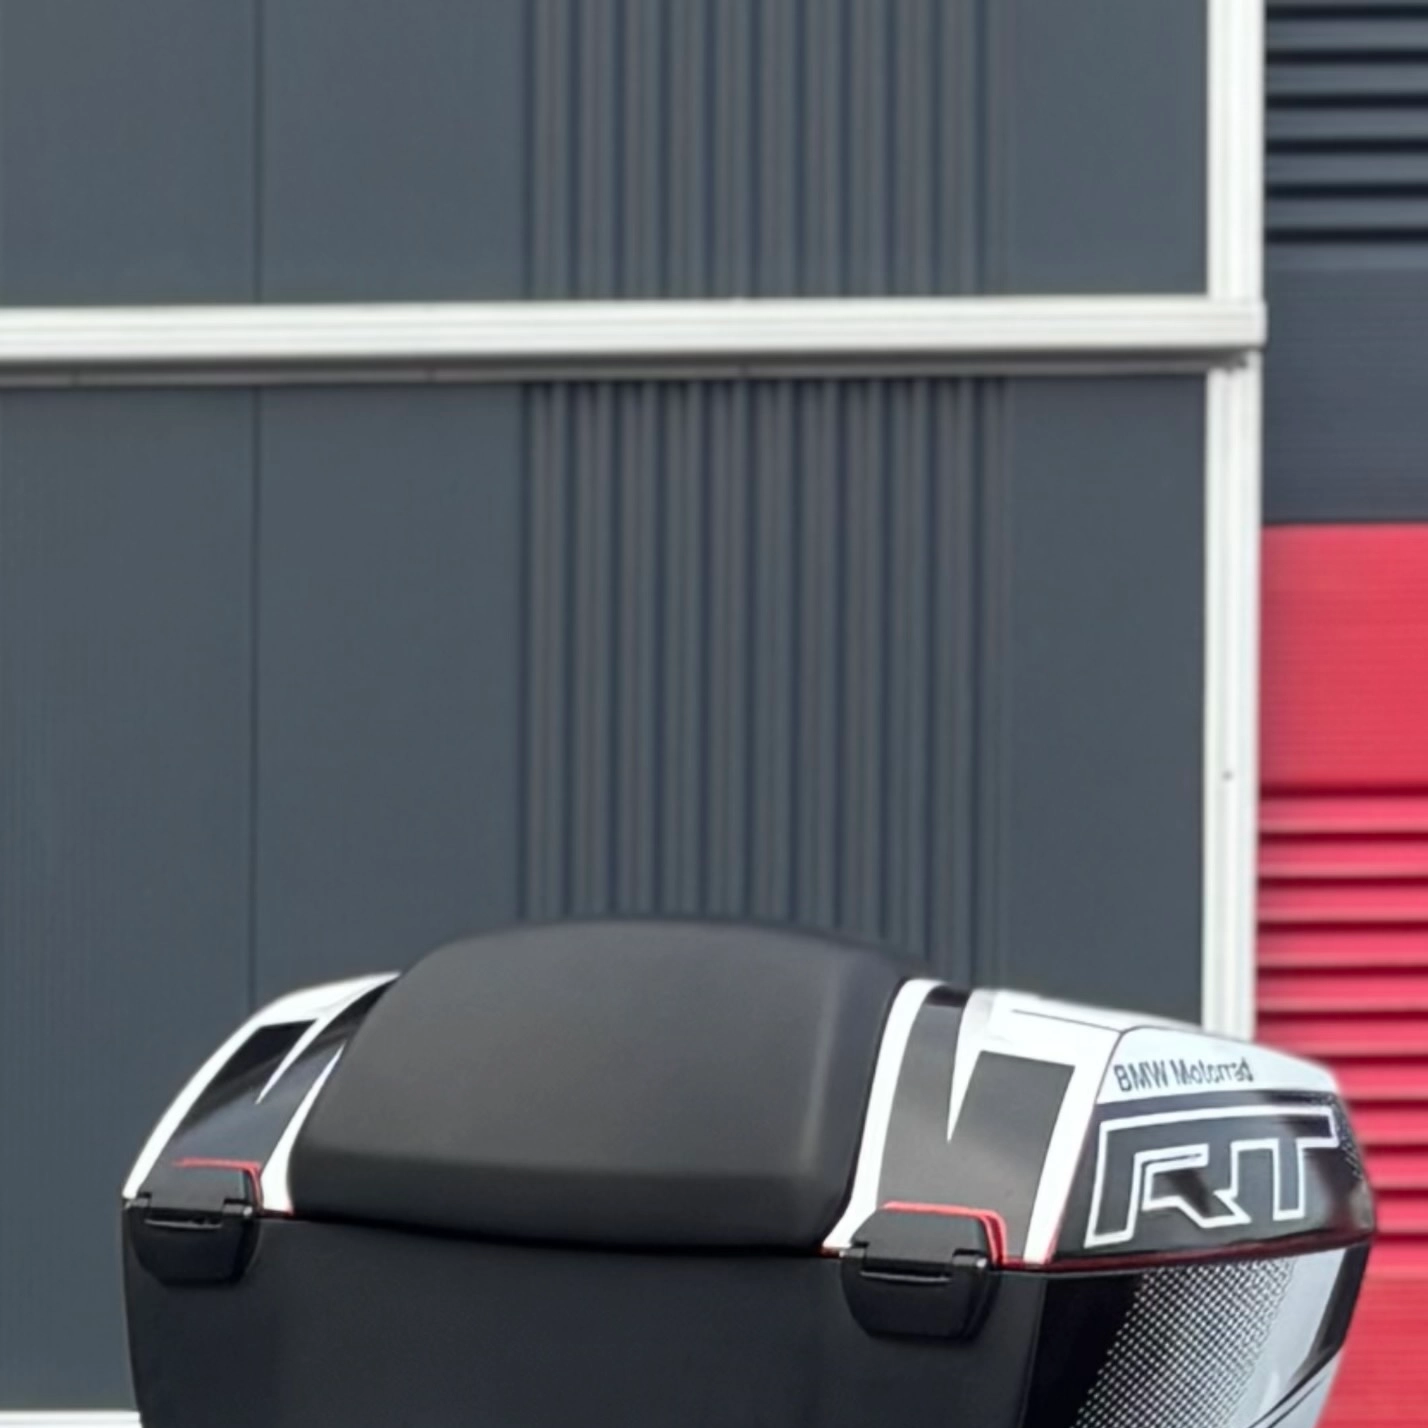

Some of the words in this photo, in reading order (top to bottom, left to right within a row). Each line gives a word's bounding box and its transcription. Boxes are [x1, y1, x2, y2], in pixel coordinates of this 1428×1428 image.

[1113, 1060, 1169, 1092] BMW
[1169, 1055, 1255, 1086] Motorrad
[1084, 1105, 1340, 1248] RT
